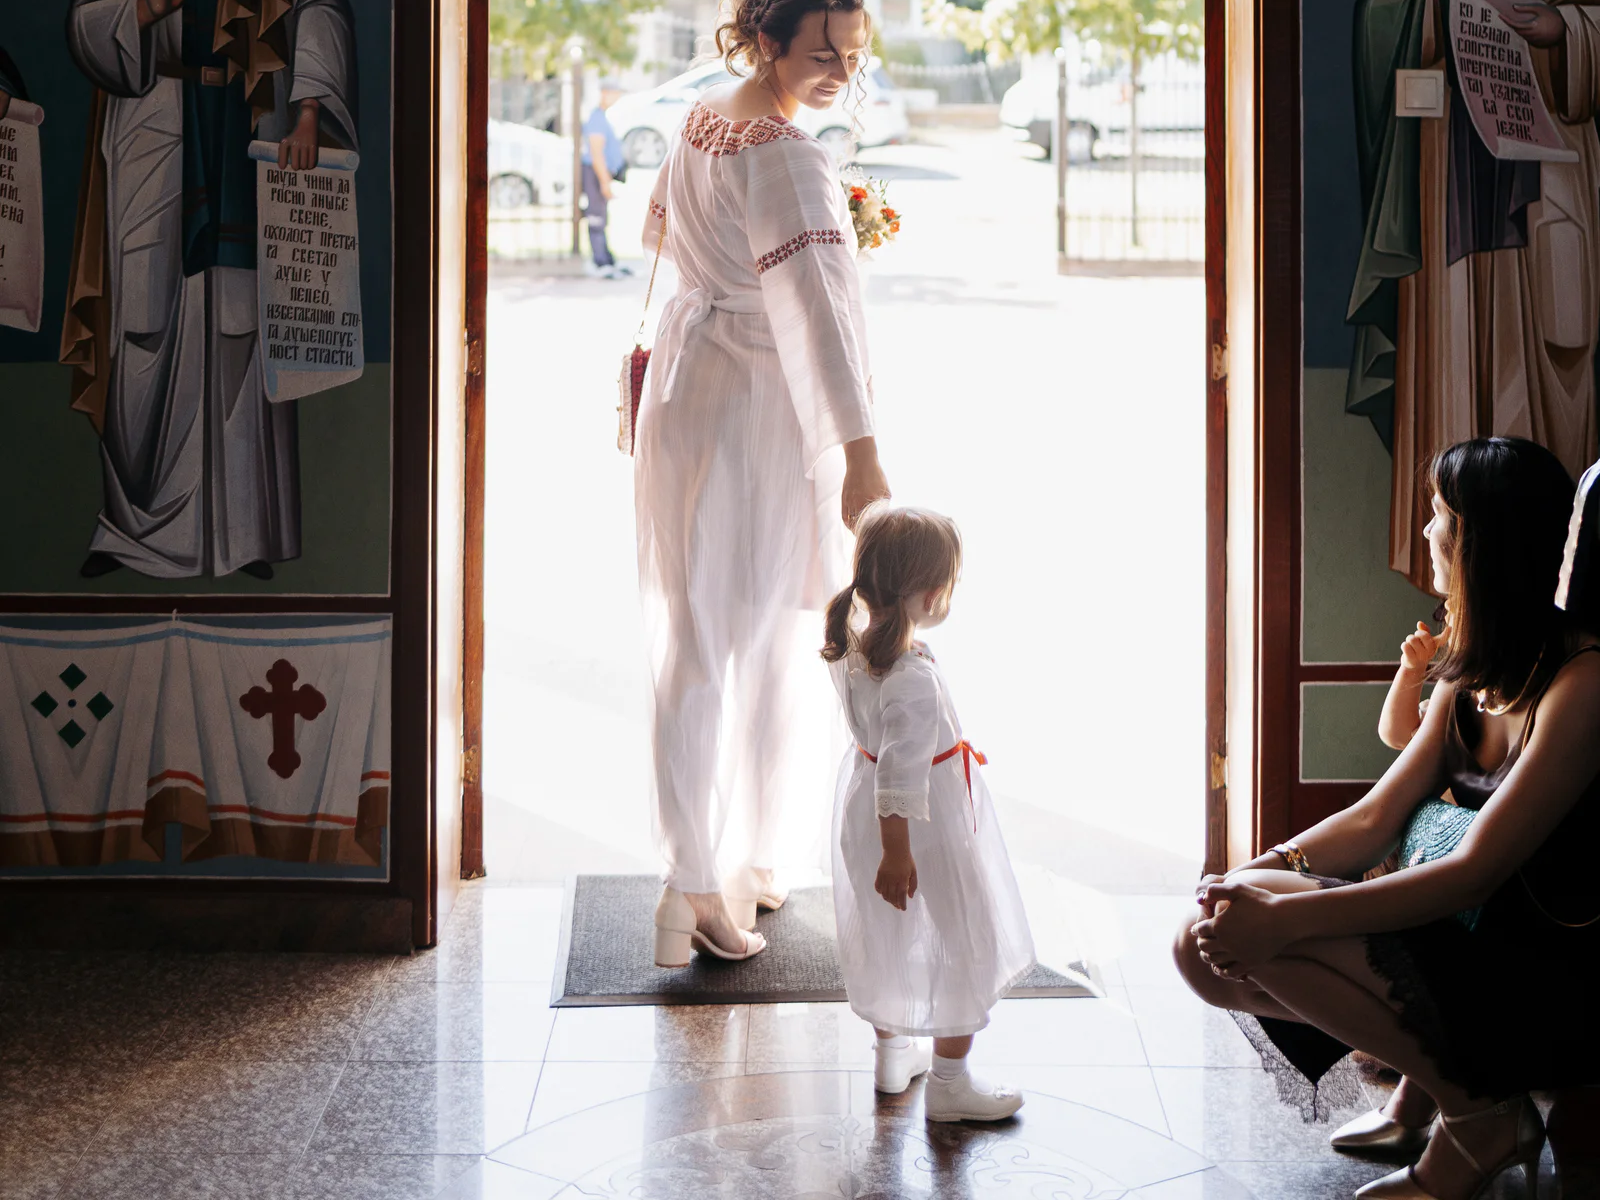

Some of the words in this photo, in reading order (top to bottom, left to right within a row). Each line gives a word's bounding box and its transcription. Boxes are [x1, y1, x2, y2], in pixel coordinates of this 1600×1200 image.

[1459, 1, 1474, 19] КО
[1459, 20, 1511, 46] СПОЗНАО
[337, 178, 350, 194] ДА
